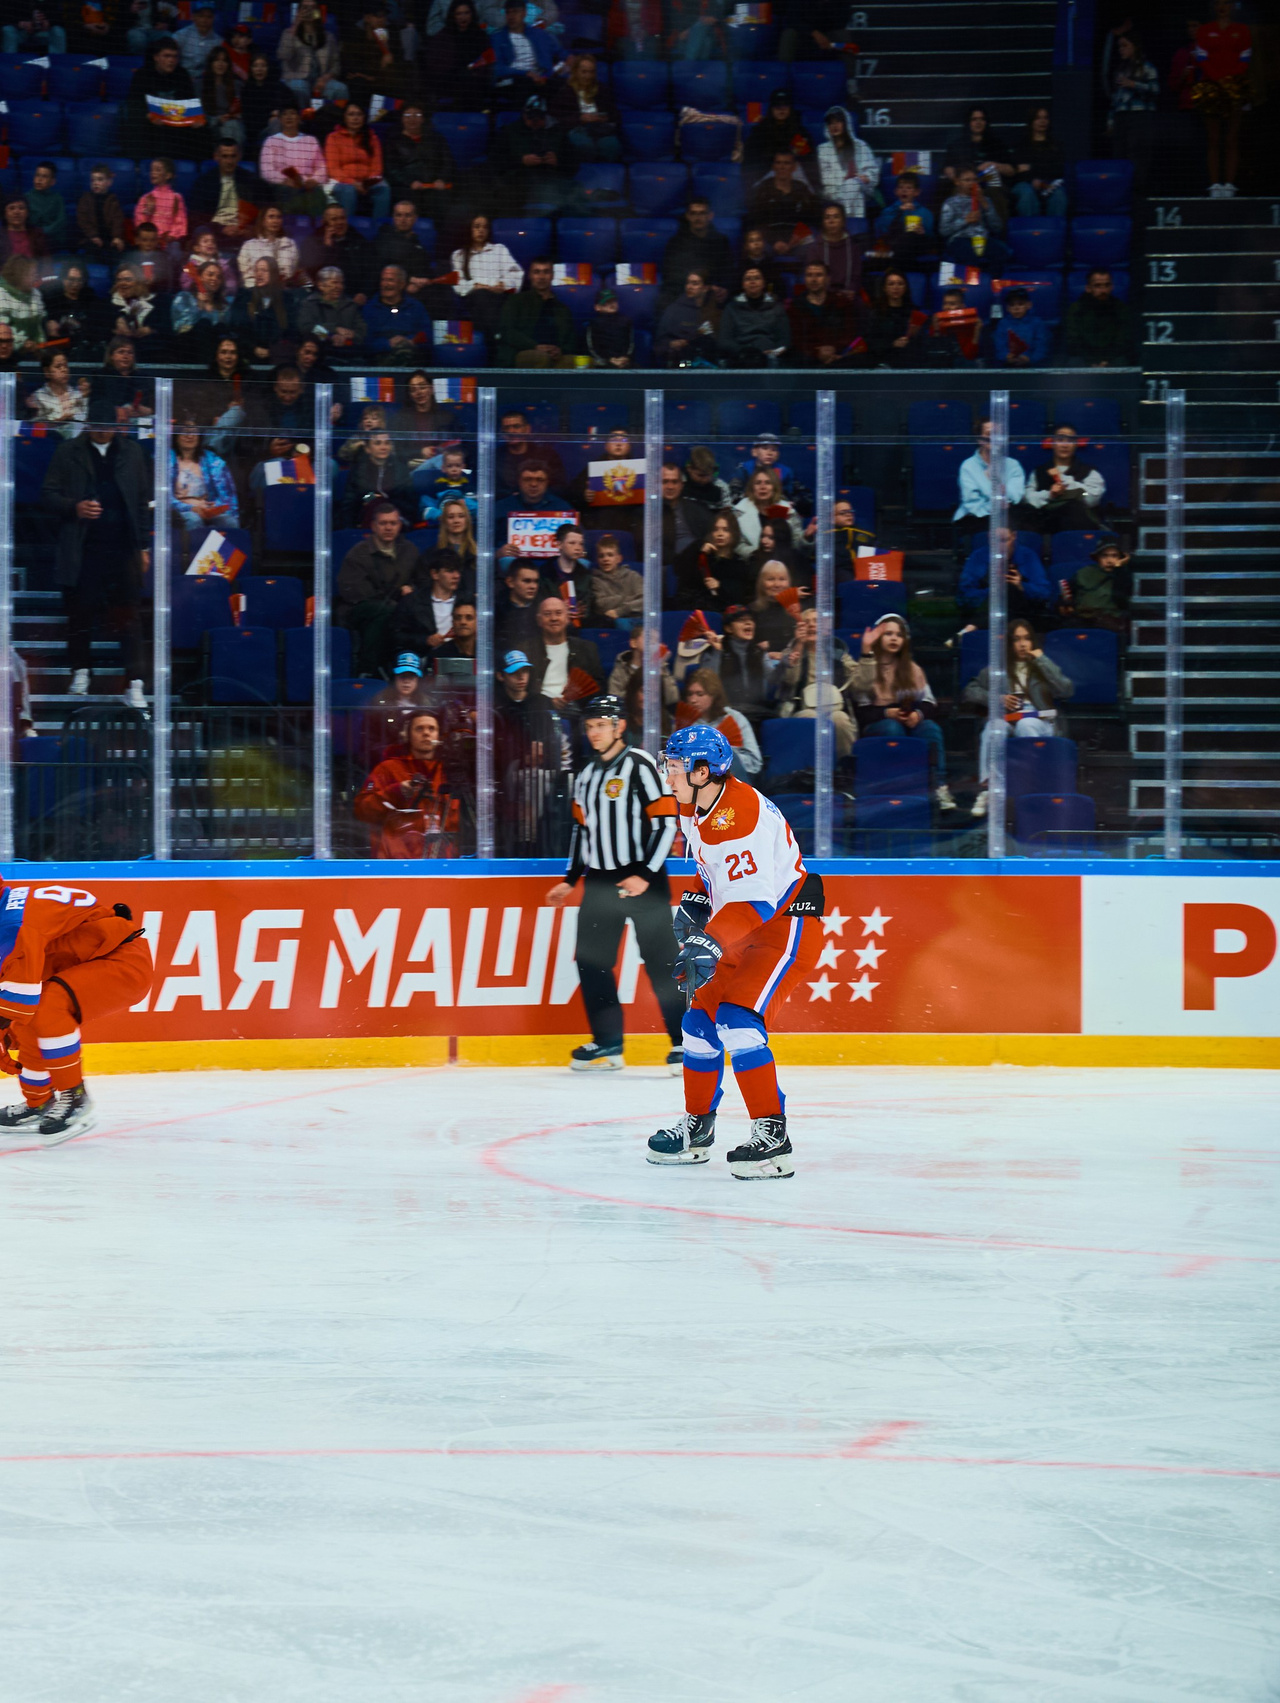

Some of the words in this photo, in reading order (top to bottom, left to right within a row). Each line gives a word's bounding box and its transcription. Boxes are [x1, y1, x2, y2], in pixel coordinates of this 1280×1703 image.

[855, 59, 879, 76] 17
[864, 107, 892, 126] 16
[1154, 206, 1183, 227] 14
[1147, 260, 1178, 282] 13
[1145, 321, 1175, 342] 12
[1145, 379, 1170, 400] 11
[725, 850, 758, 882] 23
[320, 906, 675, 1008] МАШИ
